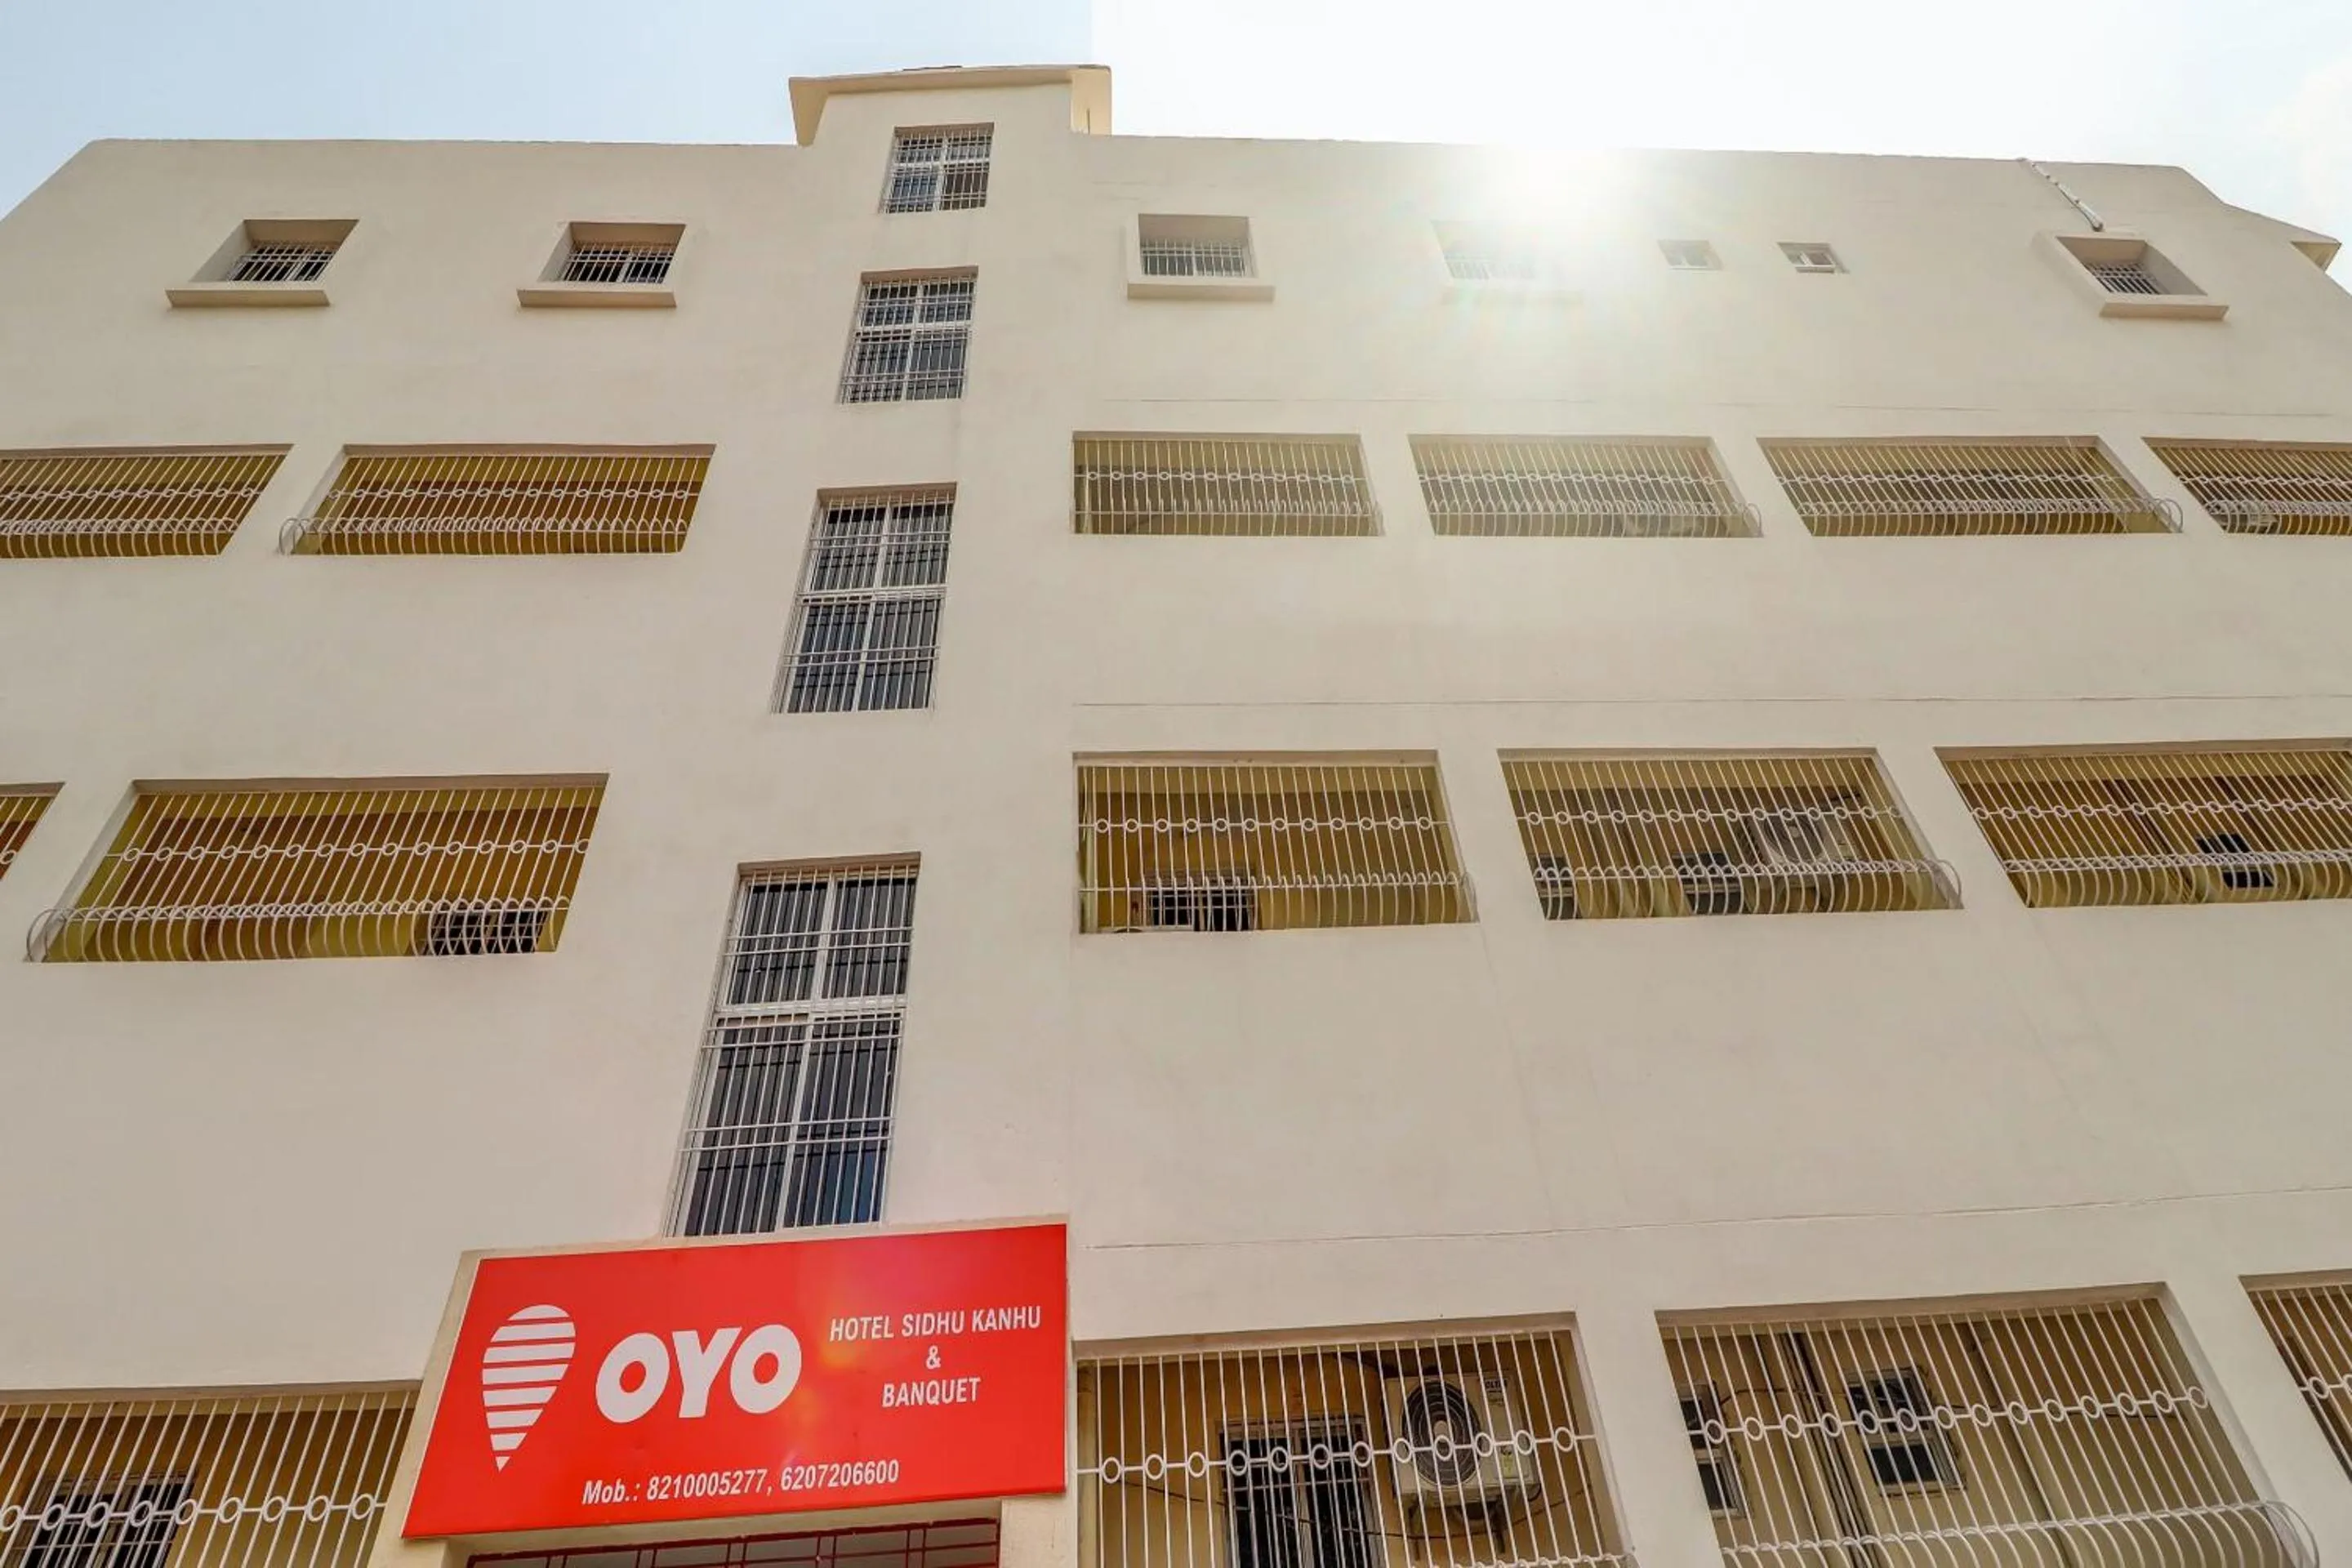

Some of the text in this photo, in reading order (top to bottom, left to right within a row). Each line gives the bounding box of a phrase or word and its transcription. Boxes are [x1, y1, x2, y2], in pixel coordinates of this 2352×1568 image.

[830, 1306, 1041, 1342] HOTEL SIDHU KANHU
[596, 1324, 802, 1423] OYO
[926, 1345, 941, 1370] &
[882, 1377, 981, 1407] BANQUET
[647, 1469, 772, 1500] 8210005277,
[781, 1459, 899, 1490] 6207206600
